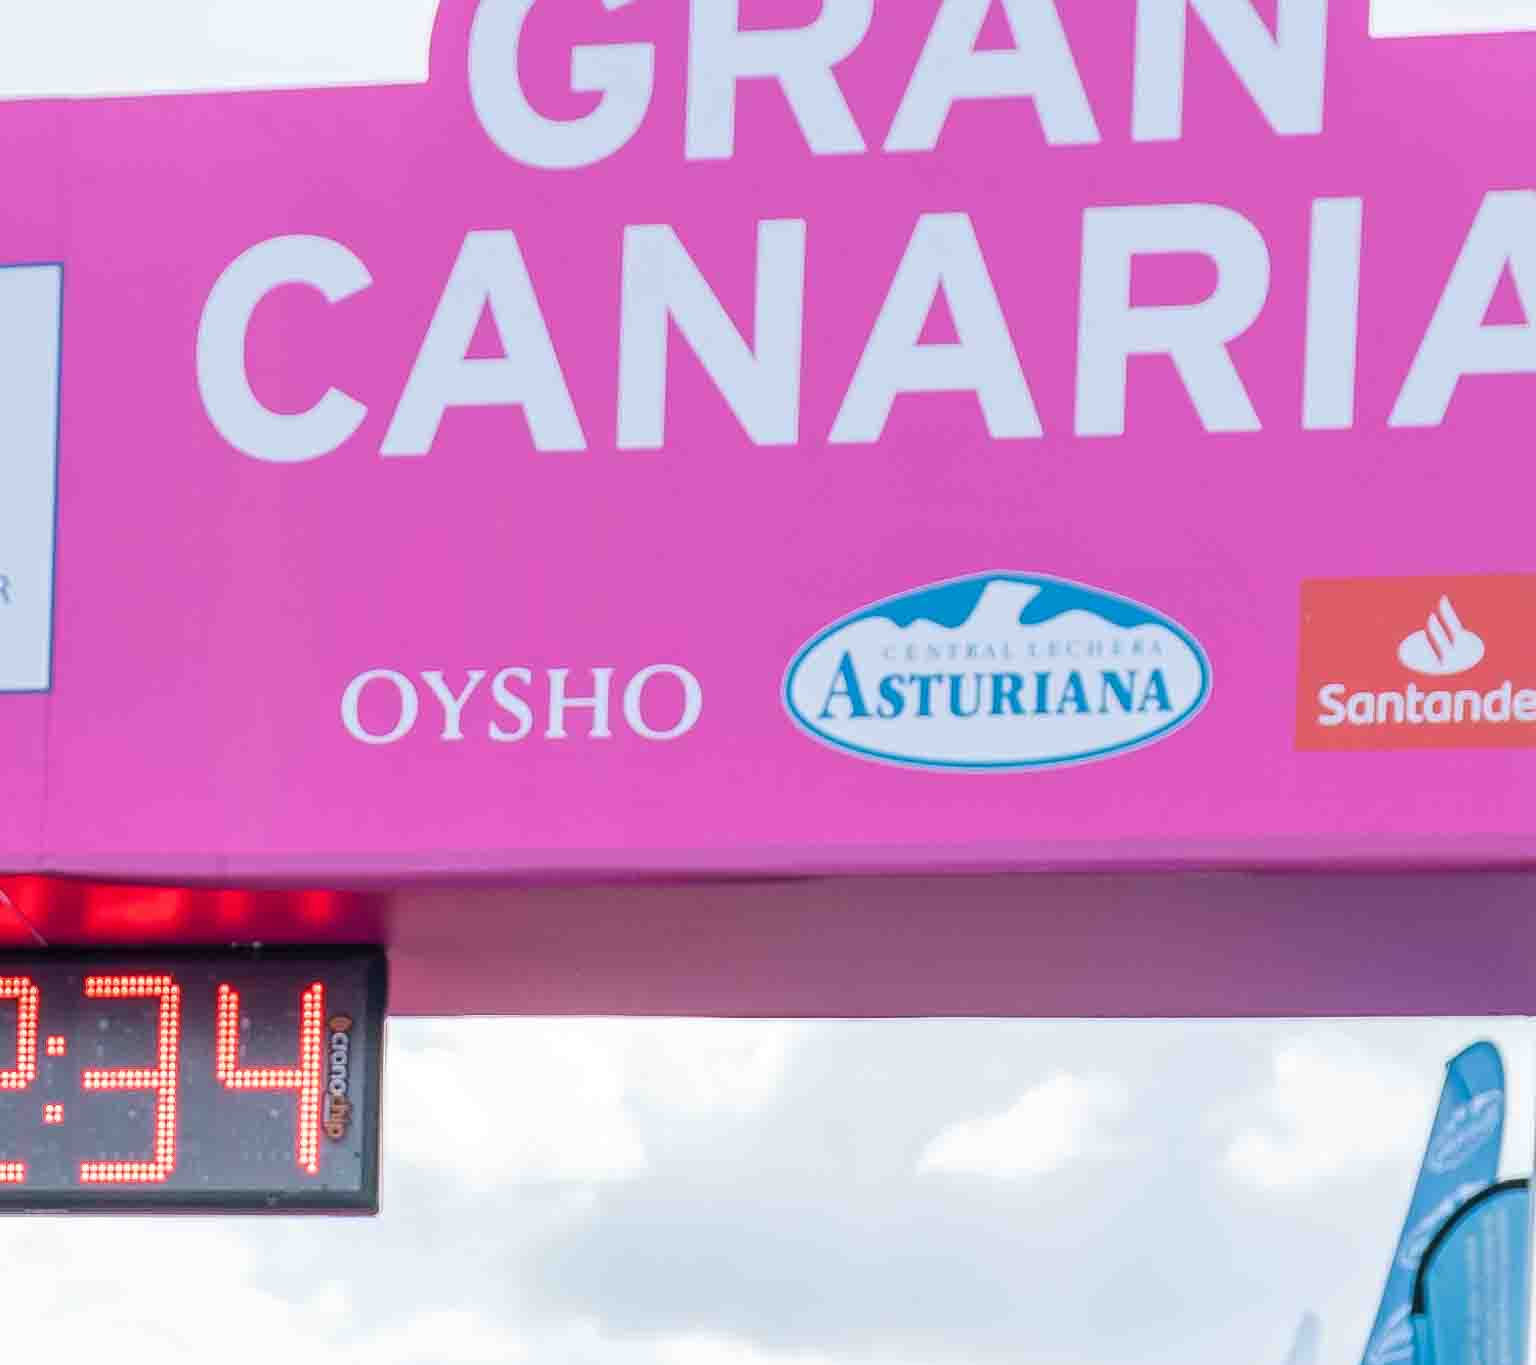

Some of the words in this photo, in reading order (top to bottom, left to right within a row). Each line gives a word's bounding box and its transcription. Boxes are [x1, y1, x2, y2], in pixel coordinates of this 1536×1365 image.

[467, 0, 1325, 168] GRAN
[341, 661, 702, 744] OYSHO
[819, 649, 1175, 720] ASTURIANA
